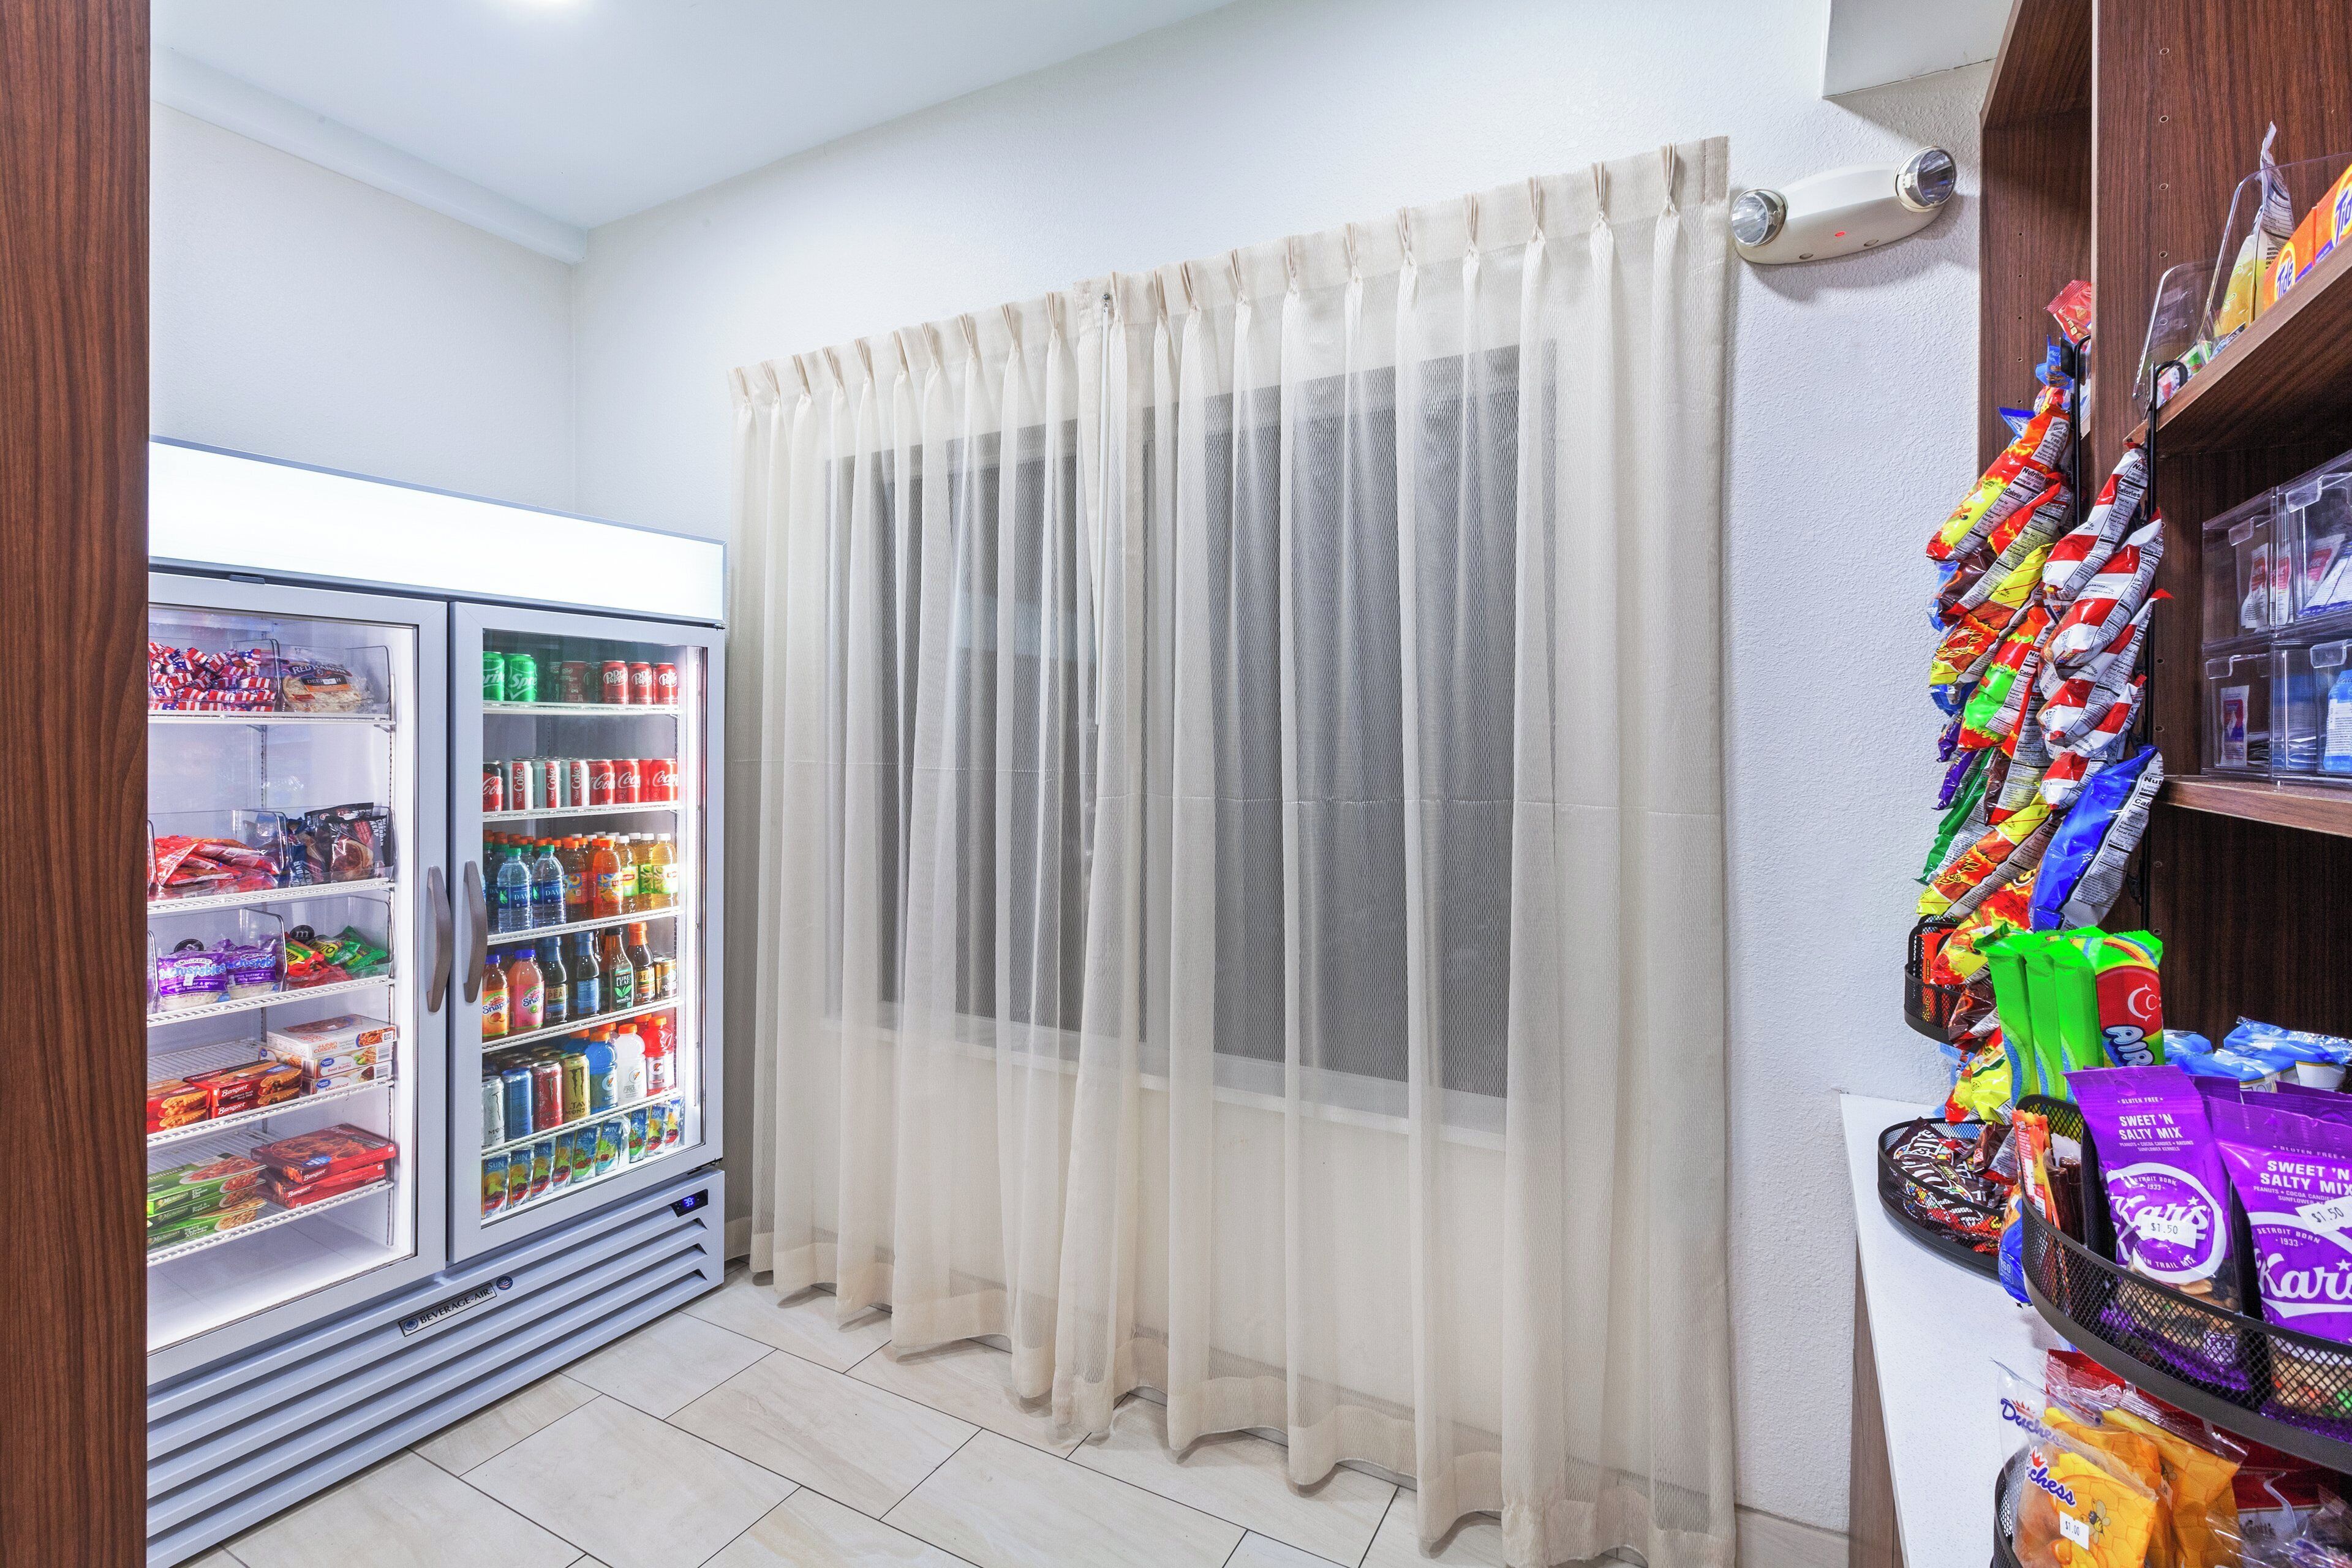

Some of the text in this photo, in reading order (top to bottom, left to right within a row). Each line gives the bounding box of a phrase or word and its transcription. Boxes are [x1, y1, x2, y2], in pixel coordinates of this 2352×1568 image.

[2277, 256, 2294, 300] Tide
[2022, 467, 2046, 482] Nutrition
[2005, 488, 2022, 500] Calories
[2141, 557, 2158, 568] Calori
[292, 665, 312, 674] RED
[605, 673, 627, 684] Pepp
[514, 767, 524, 792] Coke
[547, 767, 556, 791] Coke
[571, 766, 581, 790] Coke
[221, 1084, 249, 1097] Banquet
[217, 1102, 246, 1115] Banquet
[2119, 1113, 2174, 1127] SWEET 'N
[2118, 1126, 2184, 1140] SALTY MIX
[2280, 1145, 2339, 1159] GLUTEN FREE
[304, 1169, 326, 1182] Banquet
[2267, 1159, 2350, 1182] SWEET 'N
[2132, 1175, 2157, 1184] ETROIT
[2260, 1172, 2352, 1197] SALTY MIX
[288, 1185, 312, 1198] Banquet
[2253, 1185, 2280, 1194] PEANUTS
[2285, 1190, 2307, 1199] COCOA
[2311, 1206, 2345, 1223] $1.50
[2150, 1223, 2179, 1235] $1.50
[2256, 1227, 2321, 1244] DETROIT BORN
[2280, 1237, 2299, 1247] 1933
[2155, 1260, 2179, 1270] TRAIL
[2027, 1466, 2076, 1507] chess
[2065, 1520, 2081, 1537] $1.00
